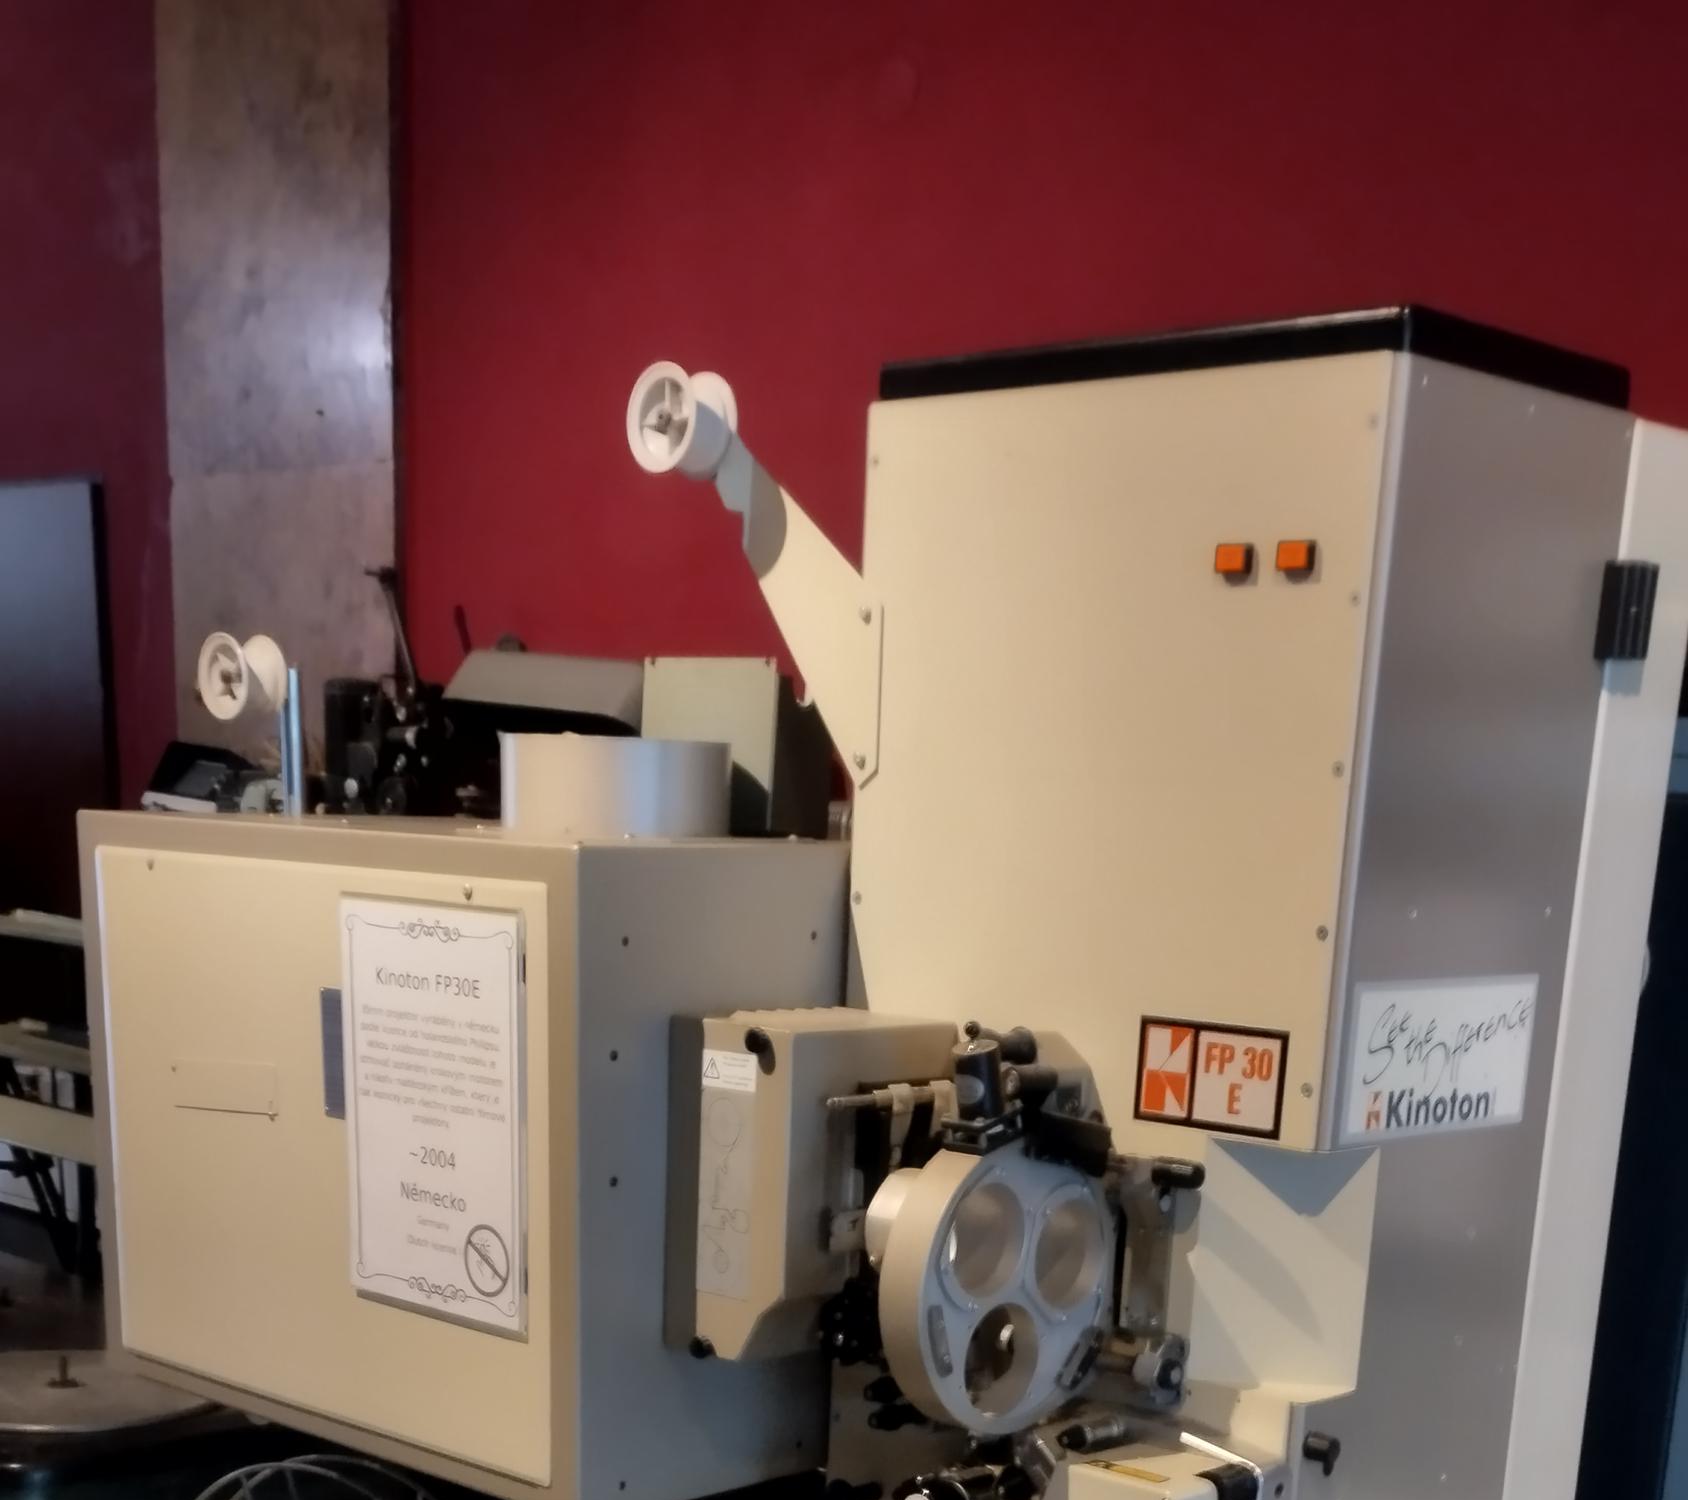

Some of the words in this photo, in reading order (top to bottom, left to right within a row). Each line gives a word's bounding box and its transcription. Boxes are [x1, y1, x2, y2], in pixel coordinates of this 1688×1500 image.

[376, 966, 430, 991] Kinoton
[435, 974, 481, 999] FP30E
[1204, 1041, 1236, 1076] FP
[1242, 1046, 1274, 1082] 30
[1227, 1082, 1243, 1115] E
[1385, 1086, 1491, 1130] Kinoton
[400, 1179, 467, 1213] Německo
